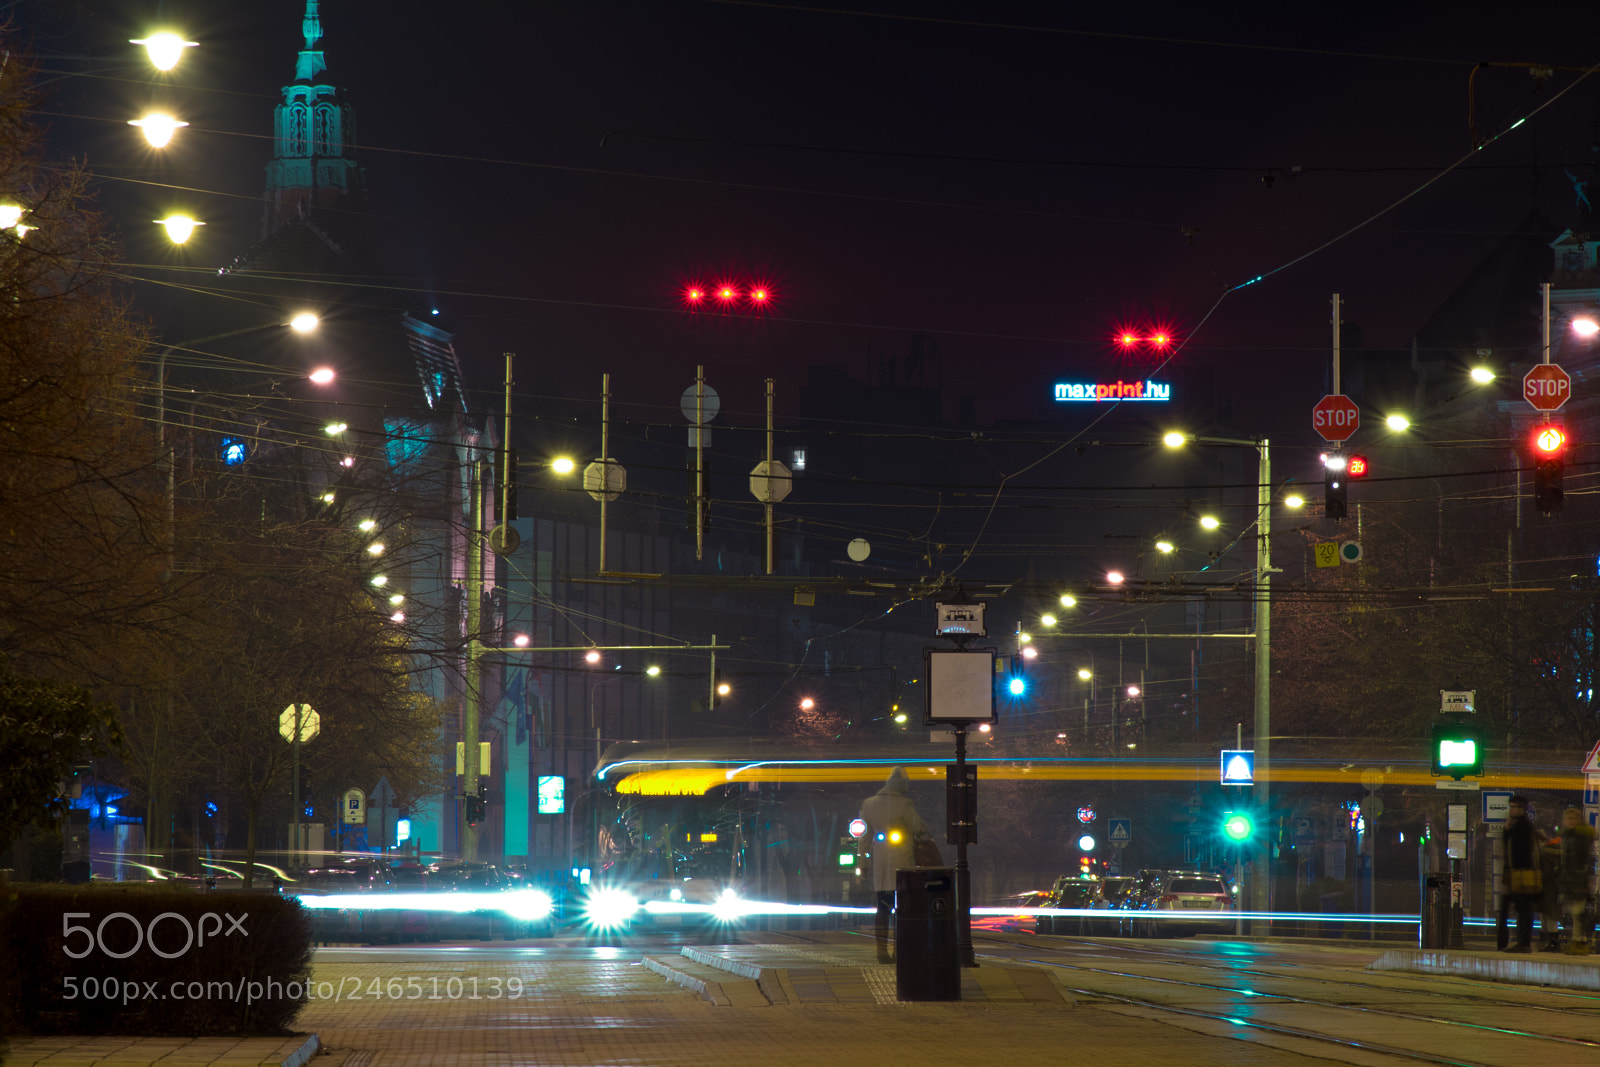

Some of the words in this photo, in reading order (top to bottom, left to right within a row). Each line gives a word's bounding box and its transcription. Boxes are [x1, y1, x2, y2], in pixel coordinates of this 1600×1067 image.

[1055, 380, 1170, 402] maxprint.hu
[1527, 379, 1567, 396] STOP
[1316, 409, 1357, 427] STOP
[1319, 544, 1335, 556] 20
